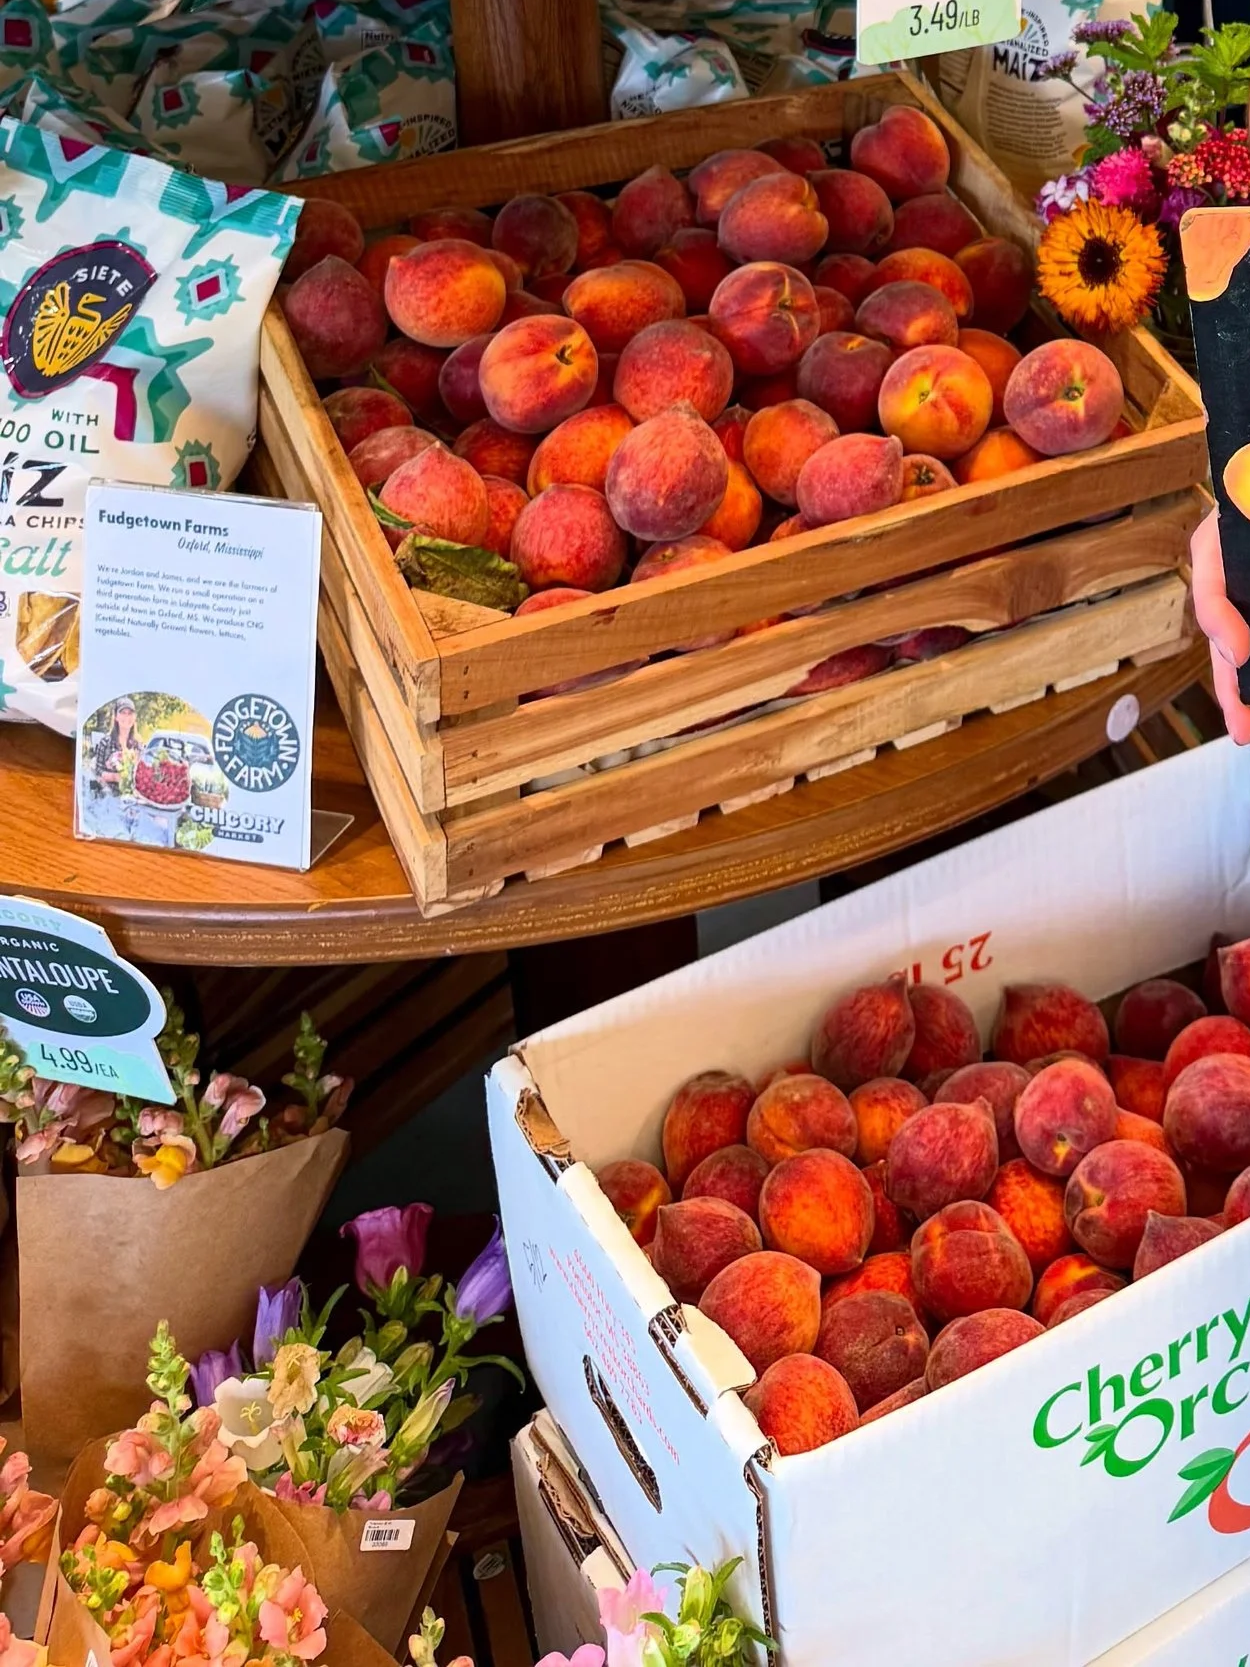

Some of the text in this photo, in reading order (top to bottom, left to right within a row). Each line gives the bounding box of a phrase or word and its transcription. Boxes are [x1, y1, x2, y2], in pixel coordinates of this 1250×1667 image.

[74, 265, 134, 298] SIETE
[52, 409, 99, 426] WITH
[44, 430, 100, 454] OIL
[98, 509, 229, 537] Fudgetown Farms
[178, 536, 265, 560] Oxford, Mississippi
[97, 576, 135, 588] Fudgetown
[212, 591, 246, 602] operation
[146, 569, 160, 579] and
[186, 575, 201, 584] and
[114, 592, 151, 602] generation
[212, 603, 237, 615] County
[127, 617, 159, 631] Naturally
[215, 697, 299, 763] FUDGETOWN
[225, 755, 284, 790] FARM
[190, 806, 285, 834] CHICORY
